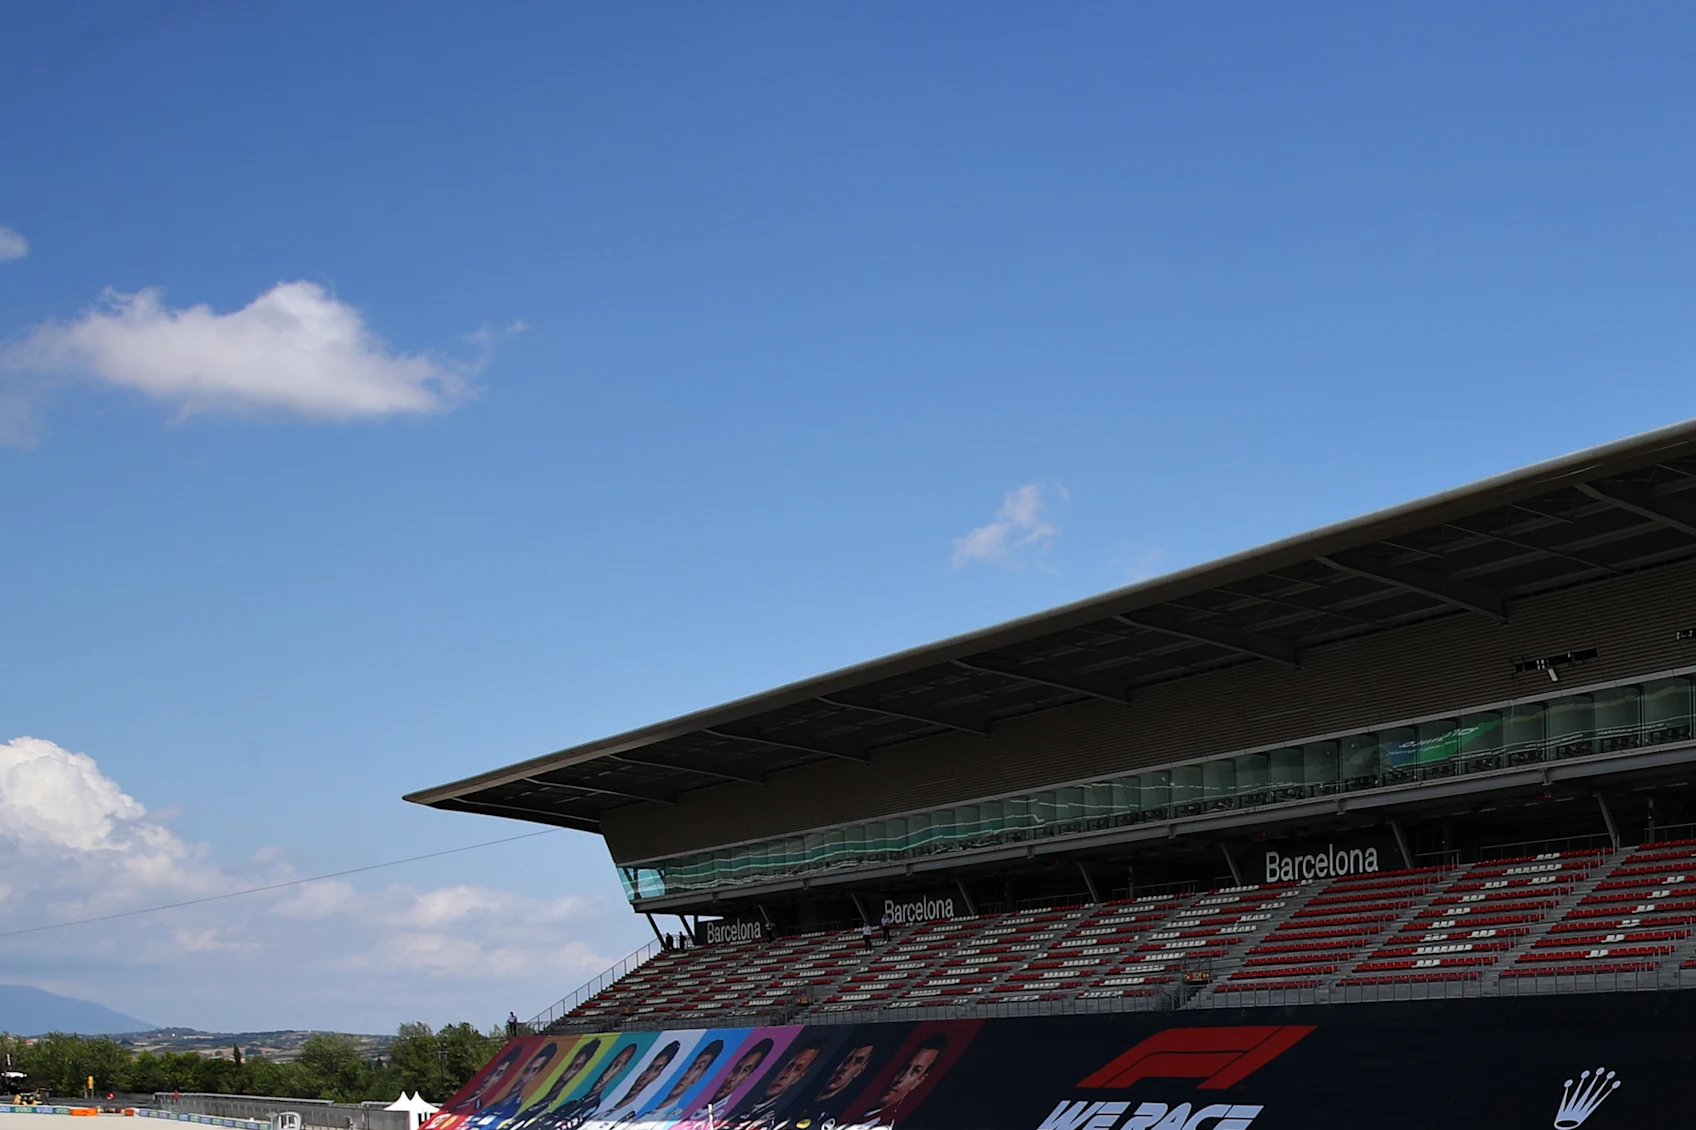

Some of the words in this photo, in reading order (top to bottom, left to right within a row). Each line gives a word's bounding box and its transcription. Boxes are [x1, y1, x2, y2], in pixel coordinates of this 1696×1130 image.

[1265, 843, 1379, 885] Barcelona
[884, 895, 954, 925] Barcelona
[706, 919, 761, 945] Barcelona
